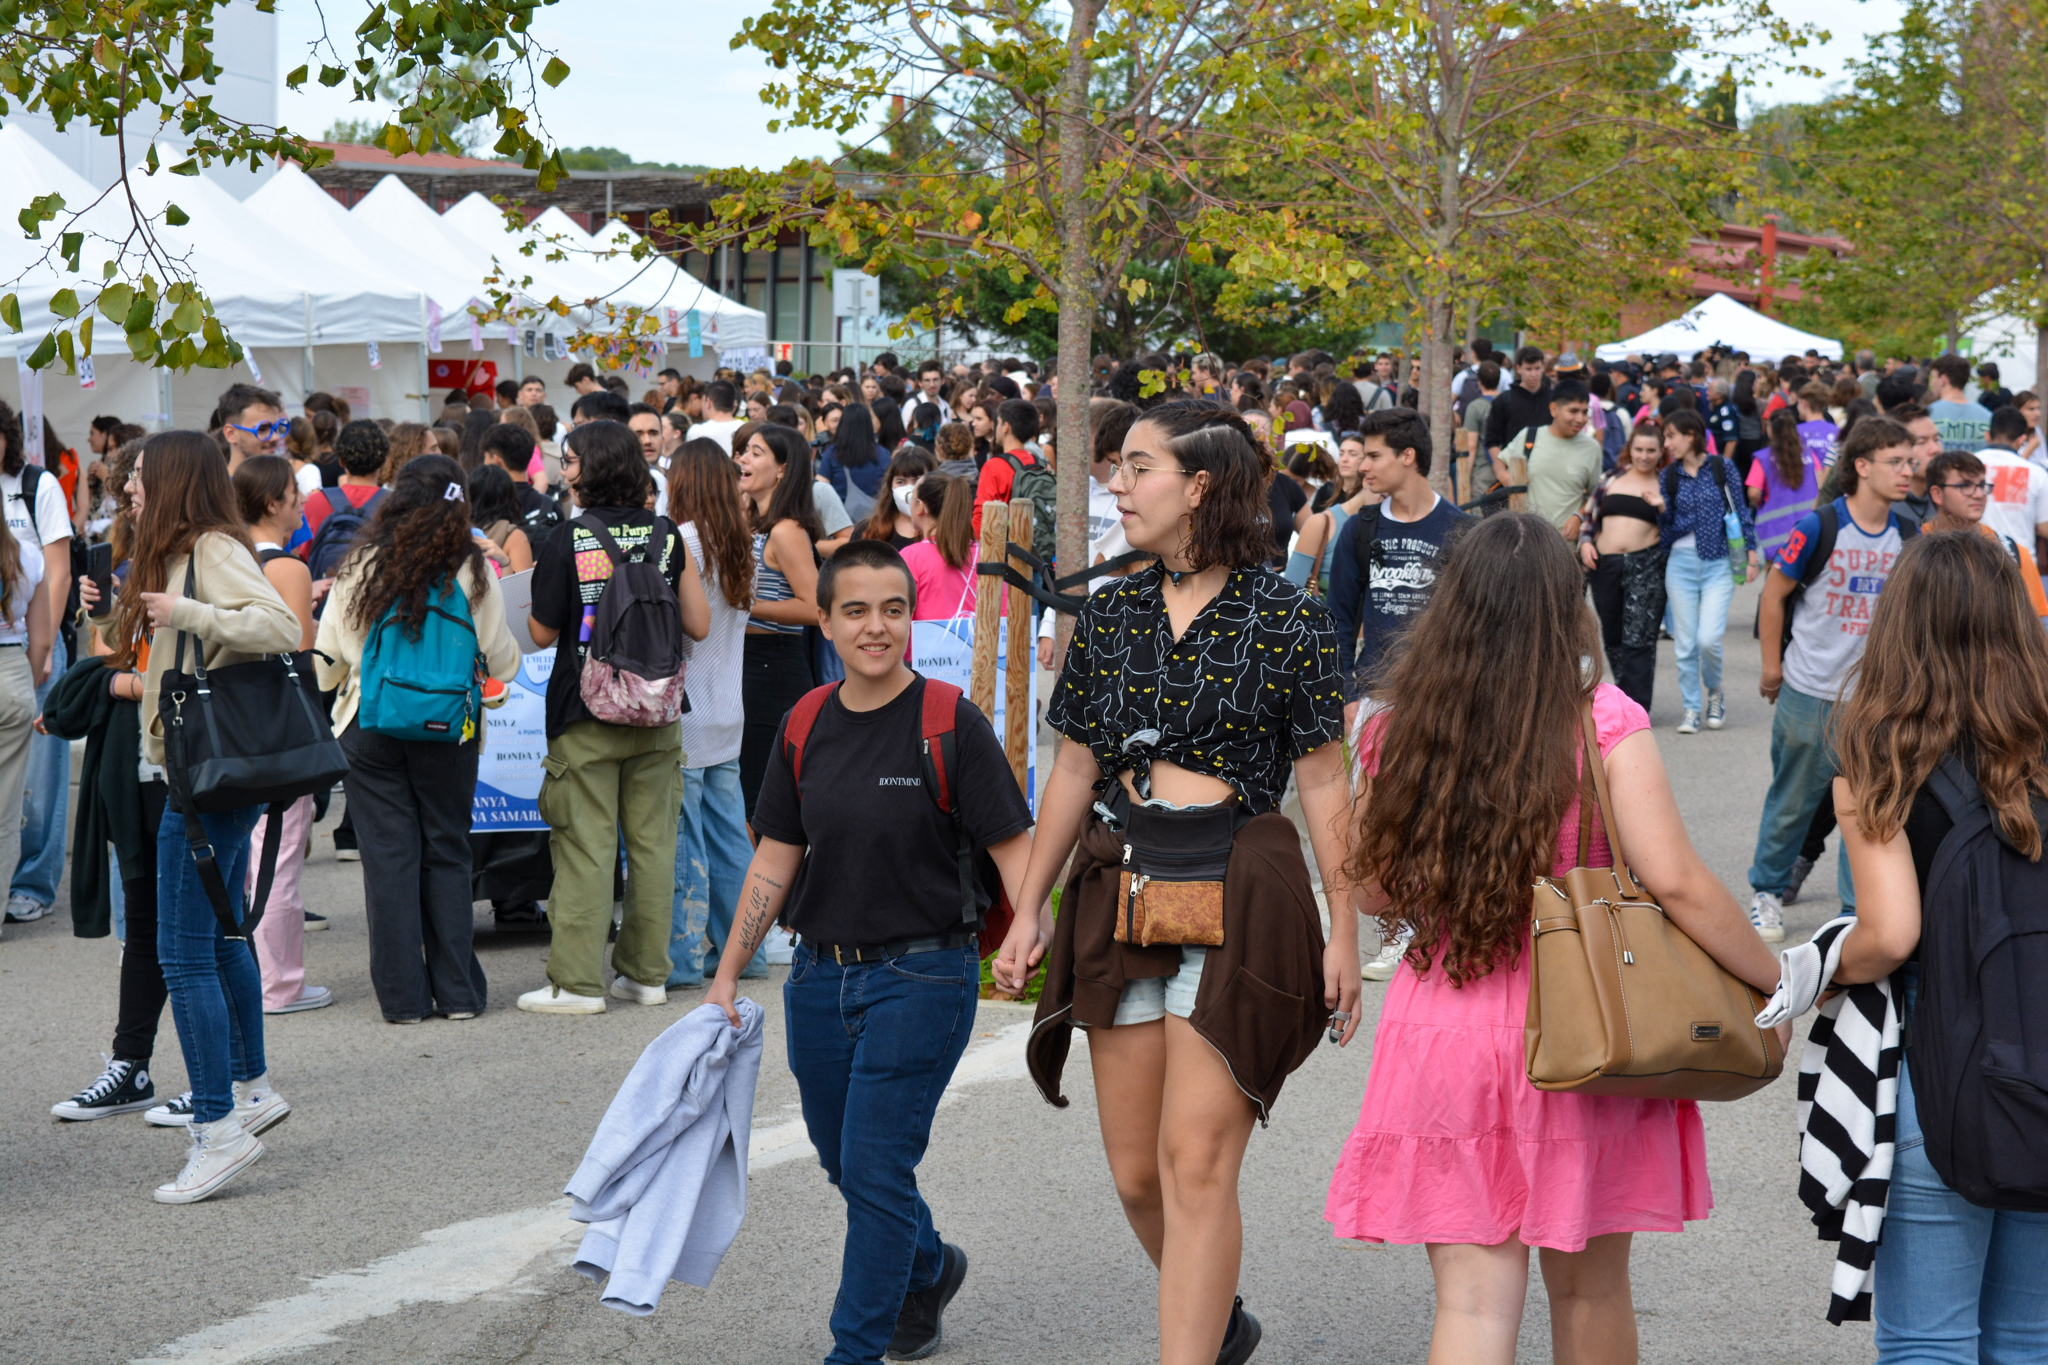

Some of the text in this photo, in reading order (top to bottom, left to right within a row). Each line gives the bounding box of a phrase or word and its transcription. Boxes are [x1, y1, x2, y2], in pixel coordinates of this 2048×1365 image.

[1401, 537, 1440, 557] PRODUCT
[1829, 549, 1894, 587] SUPE
[1825, 592, 1875, 620] TRA
[1849, 621, 1870, 636] FIE
[537, 664, 551, 672] REC
[918, 657, 952, 668] RONDA
[487, 719, 507, 727] NDA
[496, 752, 541, 761] RONDA 3
[473, 796, 508, 808] ANYA
[471, 810, 542, 823] NA SAMAR
[739, 886, 763, 949] WAKE UP
